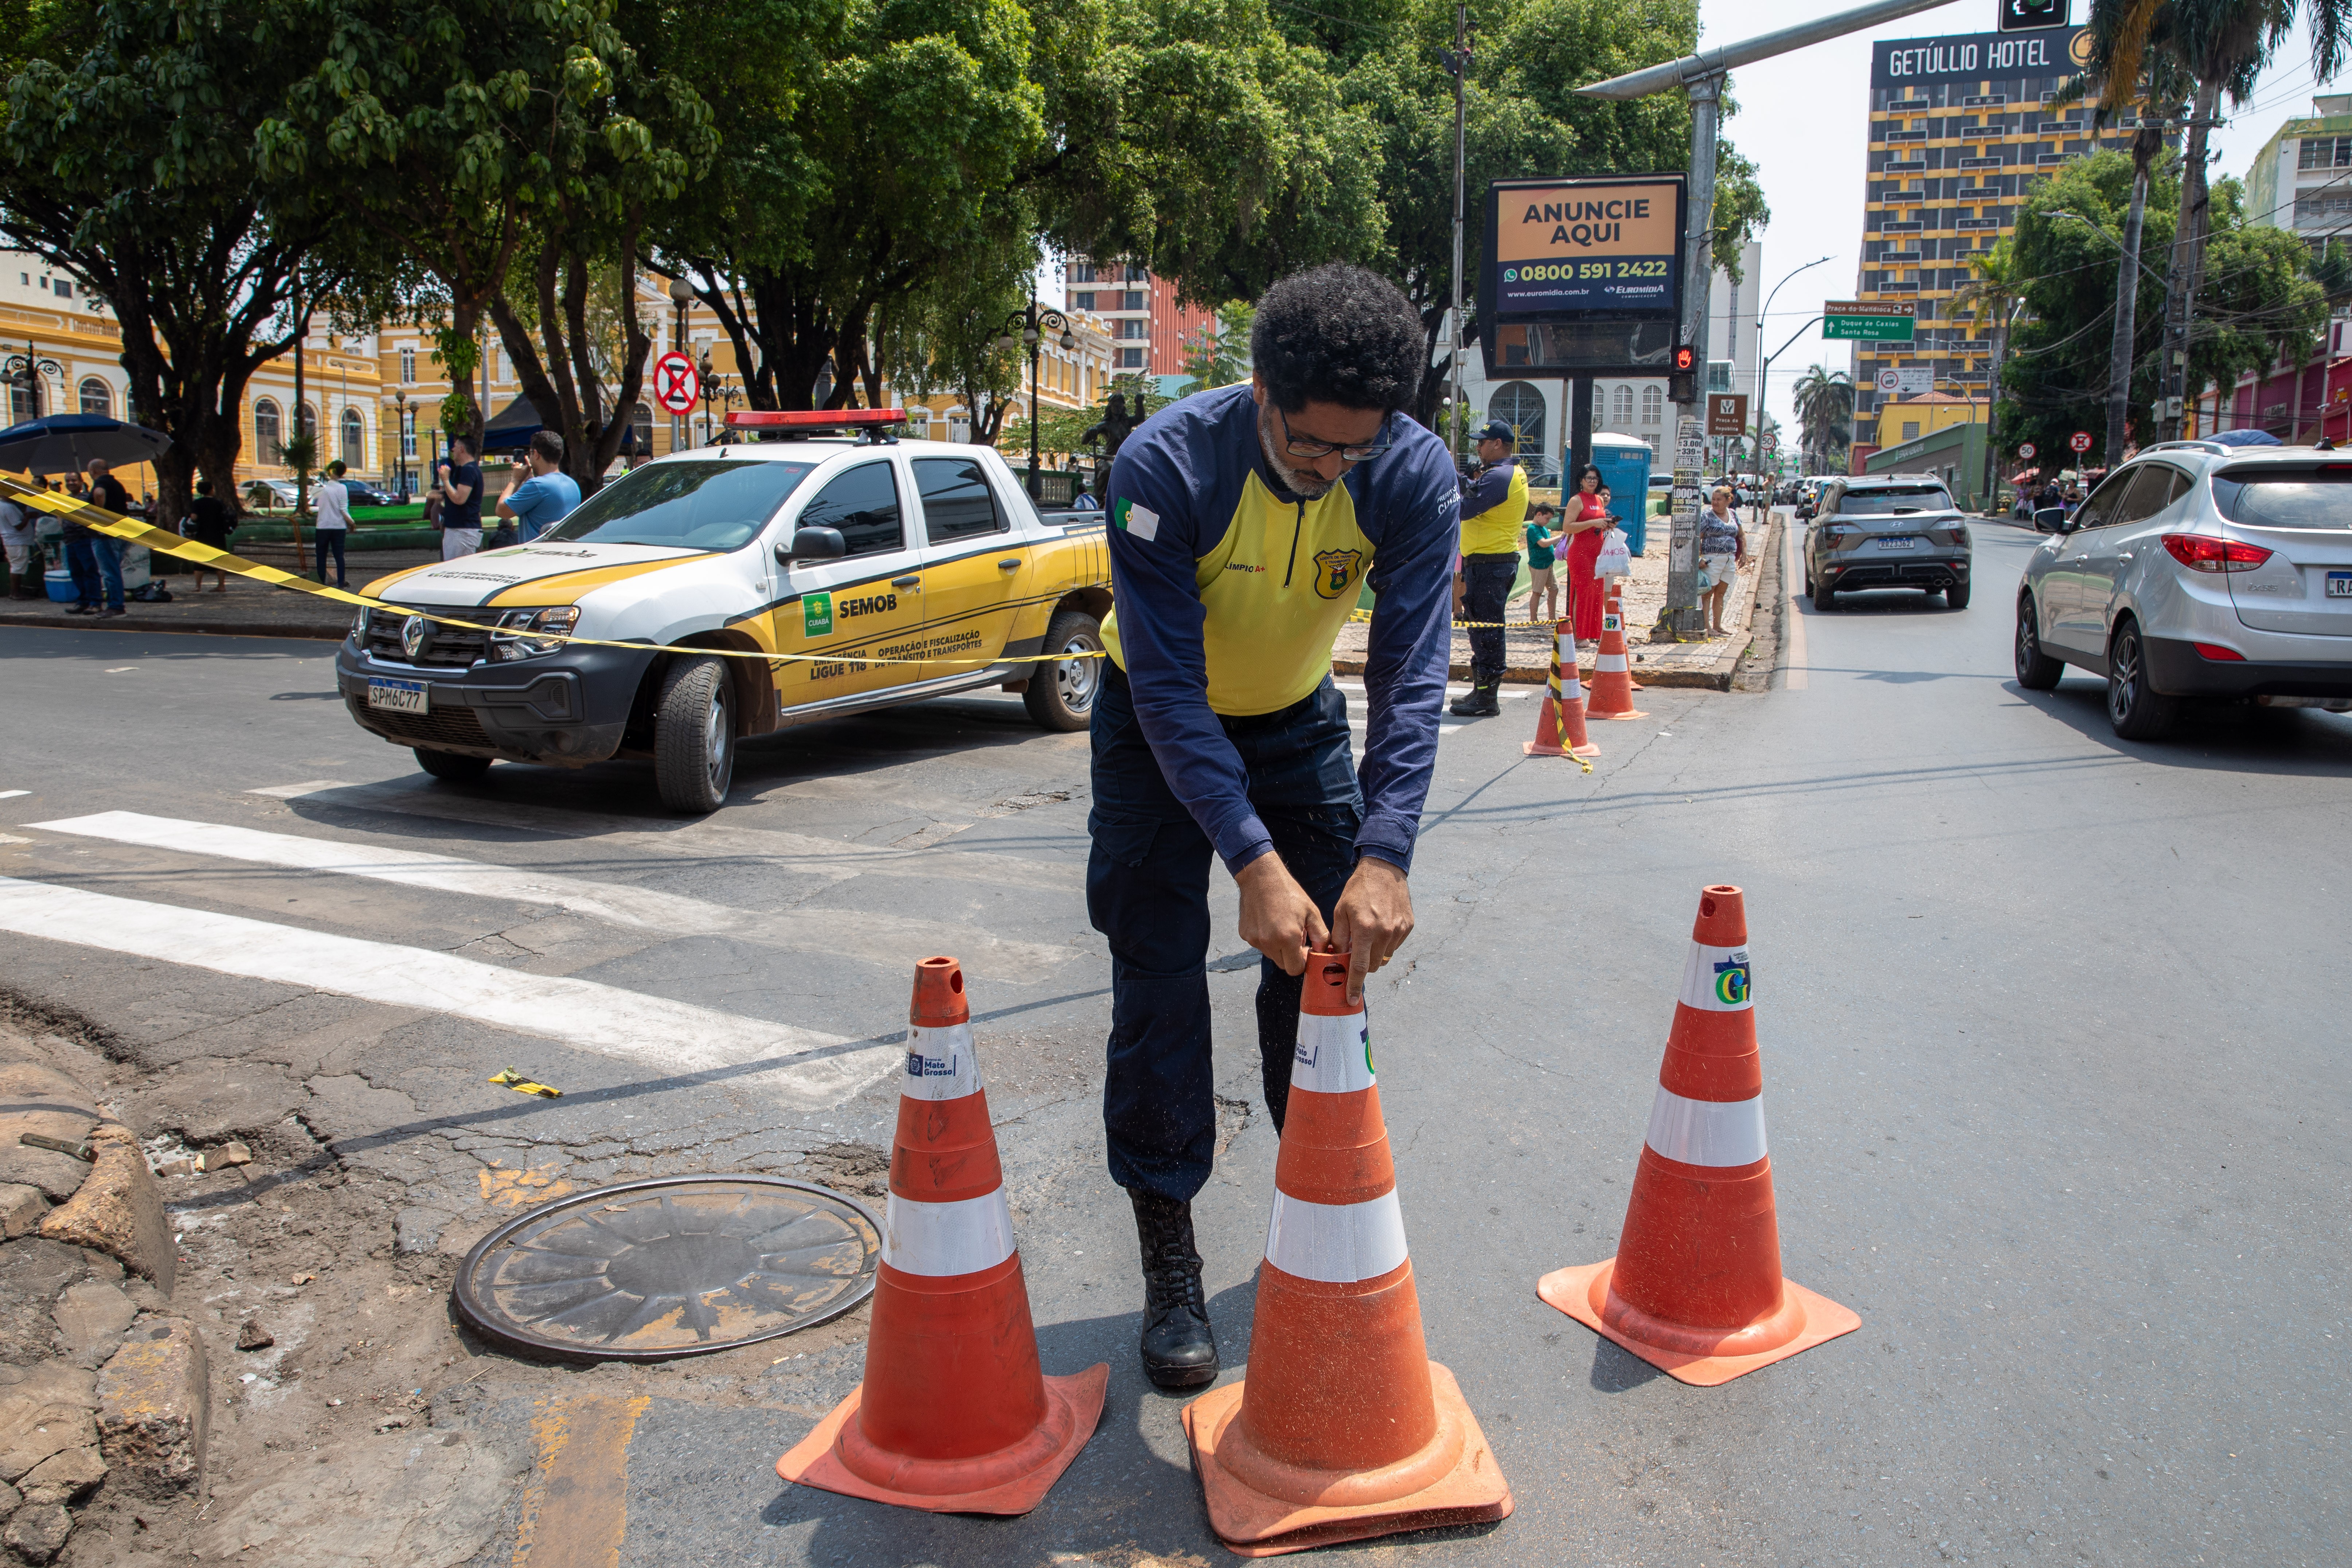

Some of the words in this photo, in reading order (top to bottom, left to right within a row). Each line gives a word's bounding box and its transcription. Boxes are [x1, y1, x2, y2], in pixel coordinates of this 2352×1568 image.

[1890, 41, 1978, 77] GETÚLLIO
[1987, 39, 2050, 69] HOTEL
[1522, 199, 1650, 224] ANUNCIE
[1550, 222, 1620, 247] AQUI
[1521, 264, 1573, 281] 0800
[1579, 262, 1611, 279] 591
[1617, 261, 1667, 278] 2422
[1507, 288, 1589, 297] www.euromidia.com.br
[1826, 305, 1846, 313] Praça
[2021, 446, 2032, 454] 50
[839, 594, 898, 619] SEMOB
[808, 616, 829, 627] CUIABÁ
[878, 641, 922, 657] OPERAÇÃO
[923, 640, 928, 649] E
[929, 629, 980, 648] FISCALIZAÇÃO
[927, 649, 931, 658] E
[933, 639, 982, 656] TRANSPORTES
[810, 663, 844, 681] LIGUE
[848, 661, 867, 673] 118
